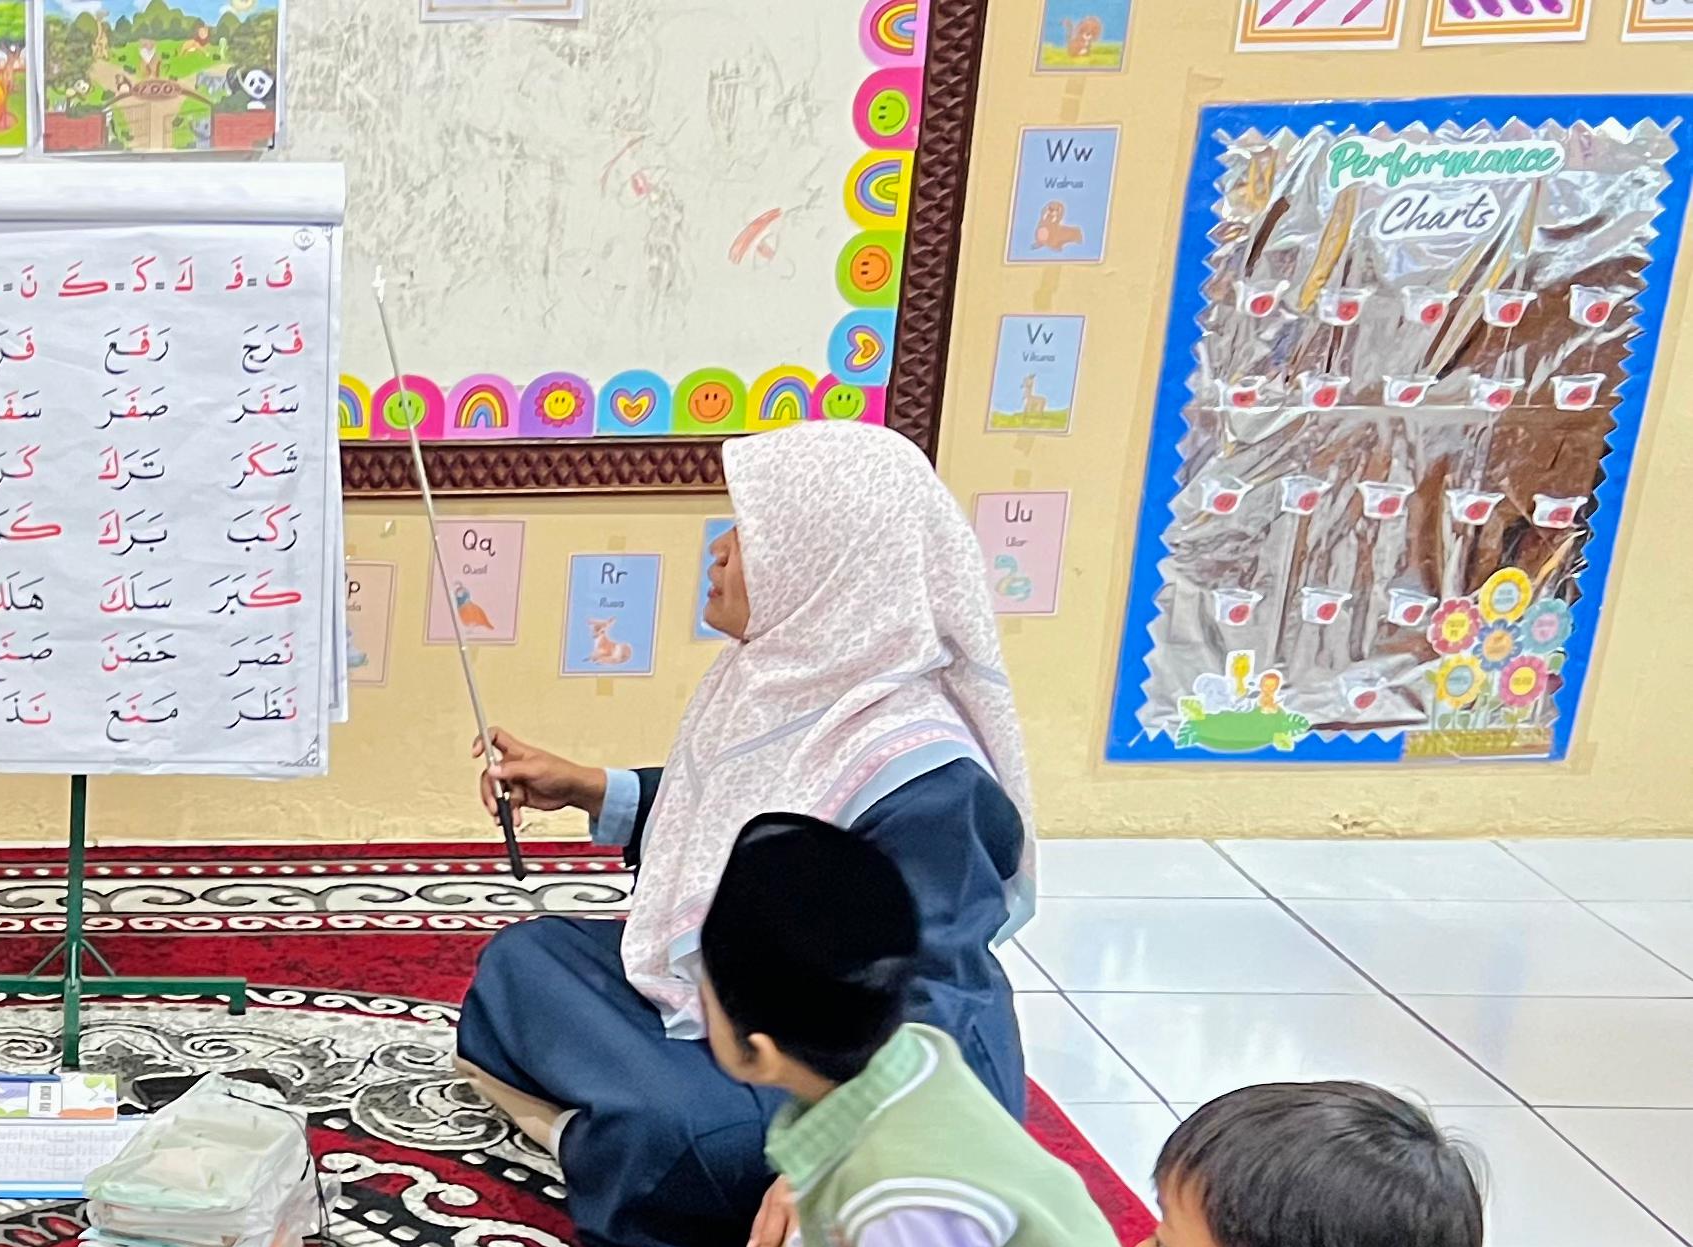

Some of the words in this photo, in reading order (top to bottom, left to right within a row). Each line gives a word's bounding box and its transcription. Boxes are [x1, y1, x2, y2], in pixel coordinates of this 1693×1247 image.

[137, 83, 175, 96] ZOO
[1046, 137, 1094, 163] Ww
[1329, 141, 1561, 188] Performance
[1044, 174, 1084, 189] Walrus
[1379, 193, 1495, 235] Charts
[1027, 323, 1054, 345] Vv
[1005, 500, 1033, 523] Uu
[462, 529, 496, 557] Qq
[601, 562, 628, 585] Rr
[600, 597, 625, 608] Rusa
